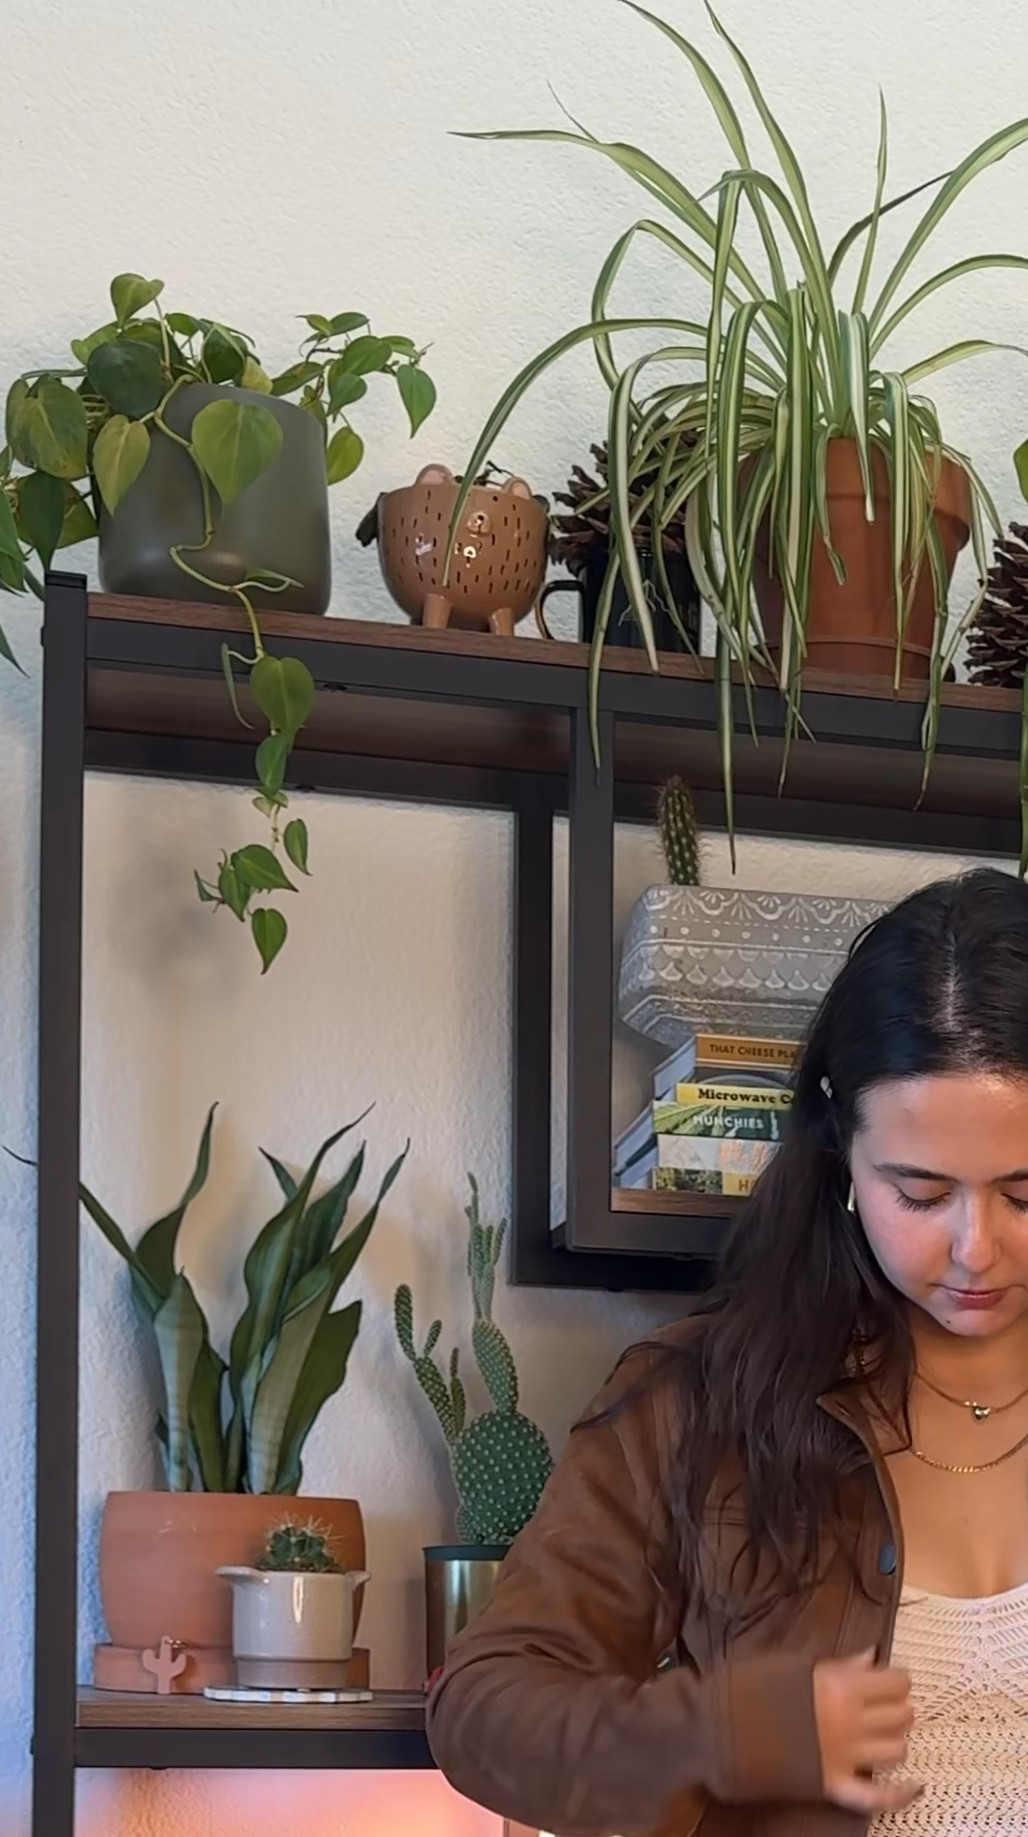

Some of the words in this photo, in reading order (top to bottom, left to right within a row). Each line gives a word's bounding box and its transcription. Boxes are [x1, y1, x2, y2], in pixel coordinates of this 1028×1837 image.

[710, 1043, 735, 1054] THAT
[737, 1046, 775, 1058] CHEESE
[778, 1049, 797, 1059] PLA
[698, 1087, 777, 1105] Microwave
[693, 1115, 765, 1130] MUNCHIES
